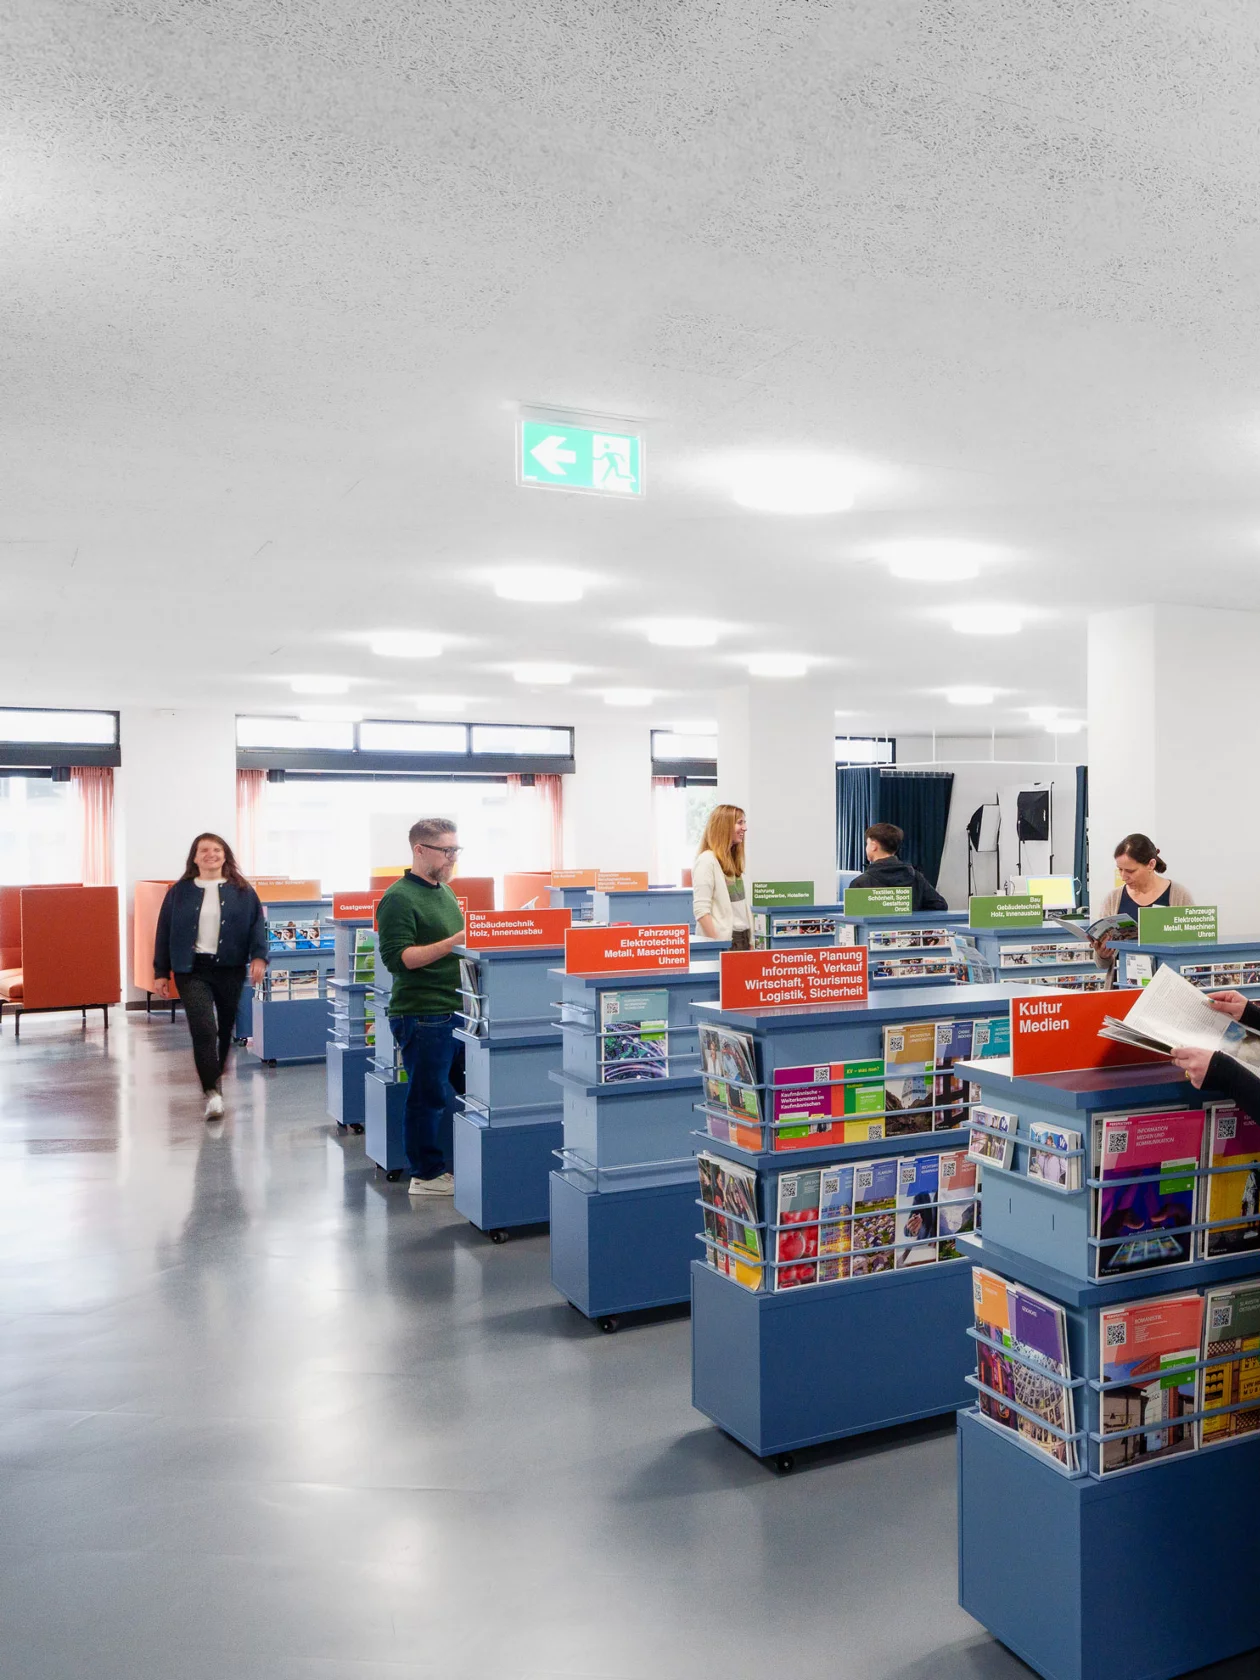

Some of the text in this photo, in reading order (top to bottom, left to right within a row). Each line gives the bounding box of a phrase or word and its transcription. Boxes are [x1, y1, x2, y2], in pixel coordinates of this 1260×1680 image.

[996, 903, 1041, 911] Gebäudetechnik
[1185, 908, 1216, 916] Fahrzeuge
[1174, 915, 1216, 923] Elektrotechnik
[470, 920, 534, 929] Gebäudetechnik
[1163, 923, 1216, 932] Metall, Maschinen
[470, 928, 542, 937] Holz, Innenausbau
[638, 928, 685, 938] Fahrzeuge
[1198, 930, 1216, 938] Uhren
[620, 938, 685, 947] Elektrotechnik
[604, 947, 685, 958] Metall, Maschinen
[658, 956, 685, 965] Uhren
[772, 951, 863, 964] Chemie, Planung
[762, 962, 863, 976] Informatik, Verkauf
[745, 975, 863, 990] Wirtschaft, Tourismus
[759, 986, 863, 1002] Logistik, Sicherheit
[1019, 1001, 1062, 1016] Kultur
[1019, 1017, 1070, 1034] Medien
[781, 1090, 818, 1098] Kaufmännische
[1137, 1126, 1168, 1134] INFORMATION
[1136, 1137, 1174, 1146] KOMMUNIKATION
